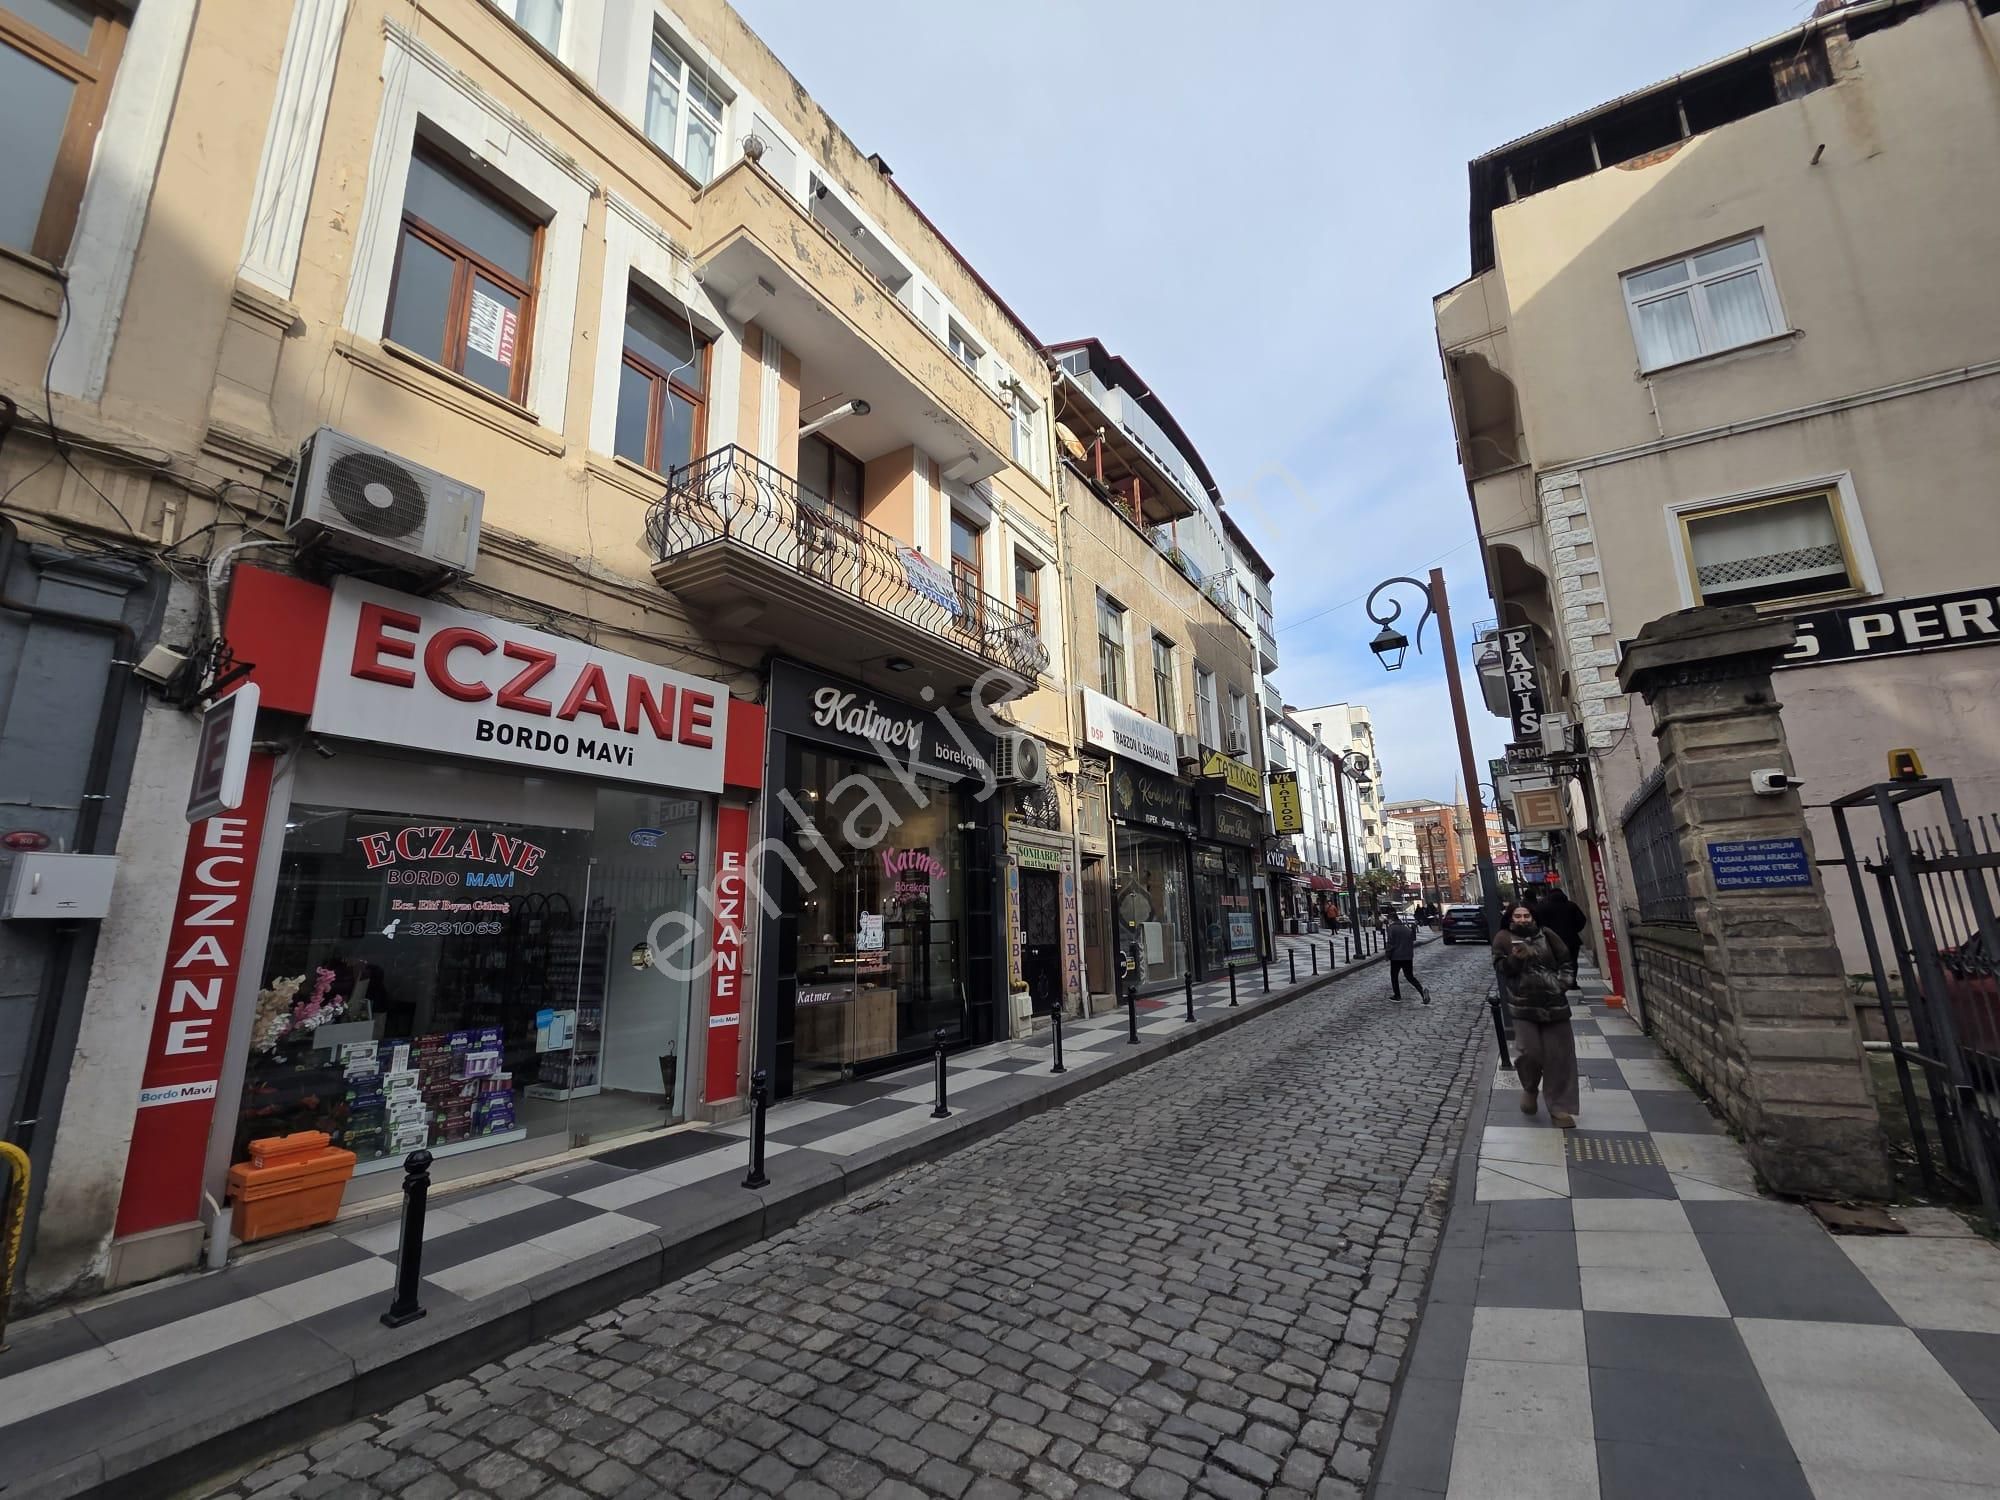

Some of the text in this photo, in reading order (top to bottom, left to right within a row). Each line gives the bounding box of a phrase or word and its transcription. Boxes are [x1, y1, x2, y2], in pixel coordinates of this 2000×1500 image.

[1848, 598, 2000, 651] PER
[351, 601, 715, 749] ECZANE
[814, 687, 919, 750] Katmer
[1091, 726, 1104, 741] DSP
[475, 719, 569, 755] BORDO
[935, 742, 985, 770] börekçim
[1216, 757, 1257, 789] TATTOOS
[1275, 774, 1290, 783] YK
[357, 826, 546, 876] ECZANE
[882, 847, 947, 880] Katmer
[1018, 845, 1060, 862] SONHABER
[1749, 864, 1771, 872] PARK
[1772, 863, 1799, 871] ETMEK
[387, 870, 515, 888] BORDO MAVİ
[1593, 862, 1611, 930] ECZANE
[164, 817, 247, 1056] ECZANE
[409, 922, 502, 936] 3231063
[717, 851, 740, 997] ECZANE
[1011, 892, 1020, 976] MATBA
[1065, 898, 1078, 987] MATBAA
[797, 991, 832, 1004] Katmer
[140, 1084, 214, 1103] Bordo Mavi
